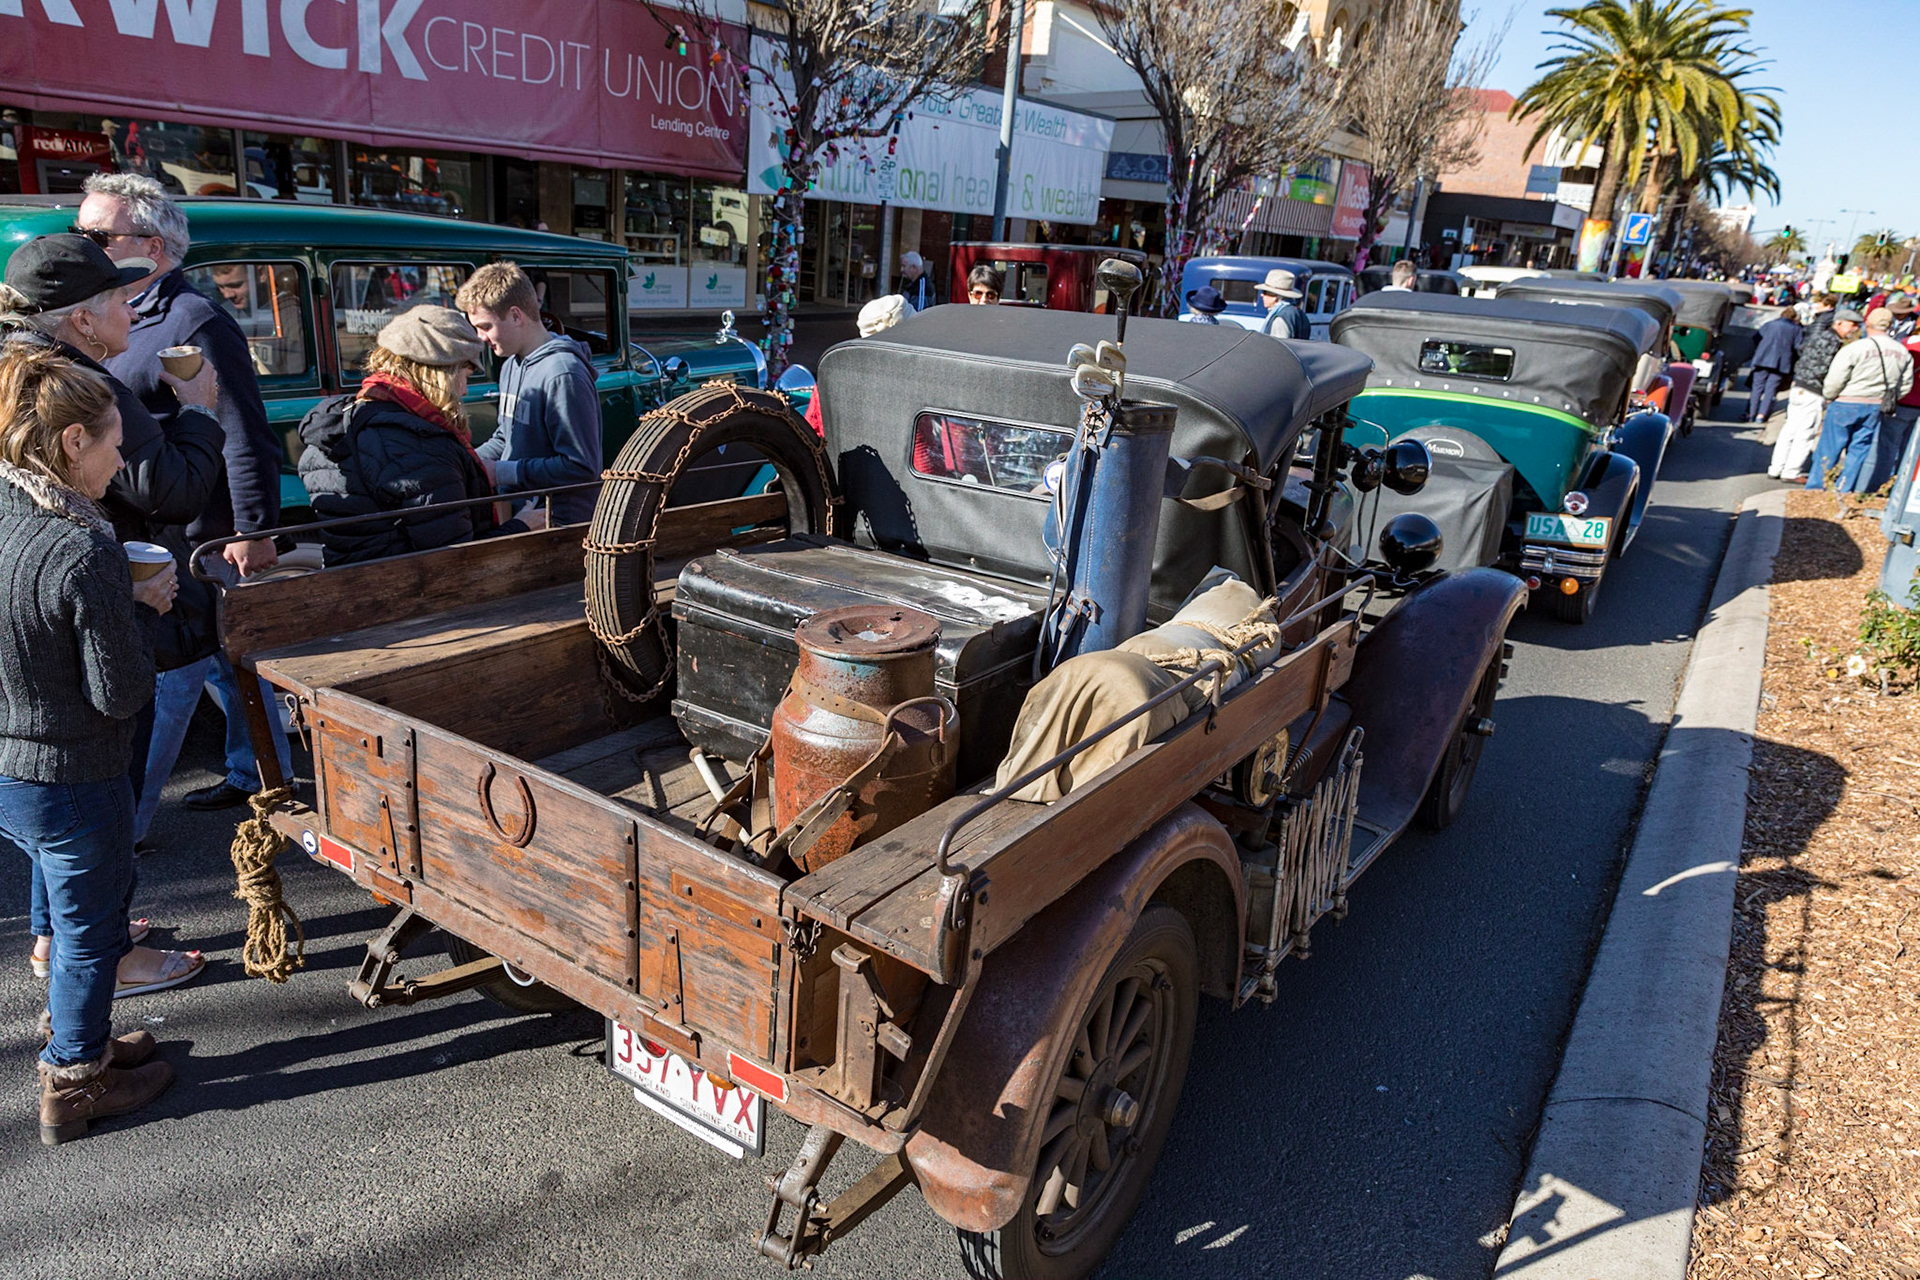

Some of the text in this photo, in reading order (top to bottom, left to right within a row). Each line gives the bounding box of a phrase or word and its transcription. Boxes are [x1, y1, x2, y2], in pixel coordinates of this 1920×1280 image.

[0, 0, 735, 117] WICK CREDIT UNION
[651, 113, 730, 140] Lending Centre
[958, 94, 1019, 131] Greatt
[1023, 109, 1068, 139] Wealth
[33, 132, 95, 154] rediATM
[1021, 173, 1034, 211] &
[1041, 181, 1097, 217] wealth
[1529, 516, 1566, 536] USA
[1583, 521, 1604, 539] 28
